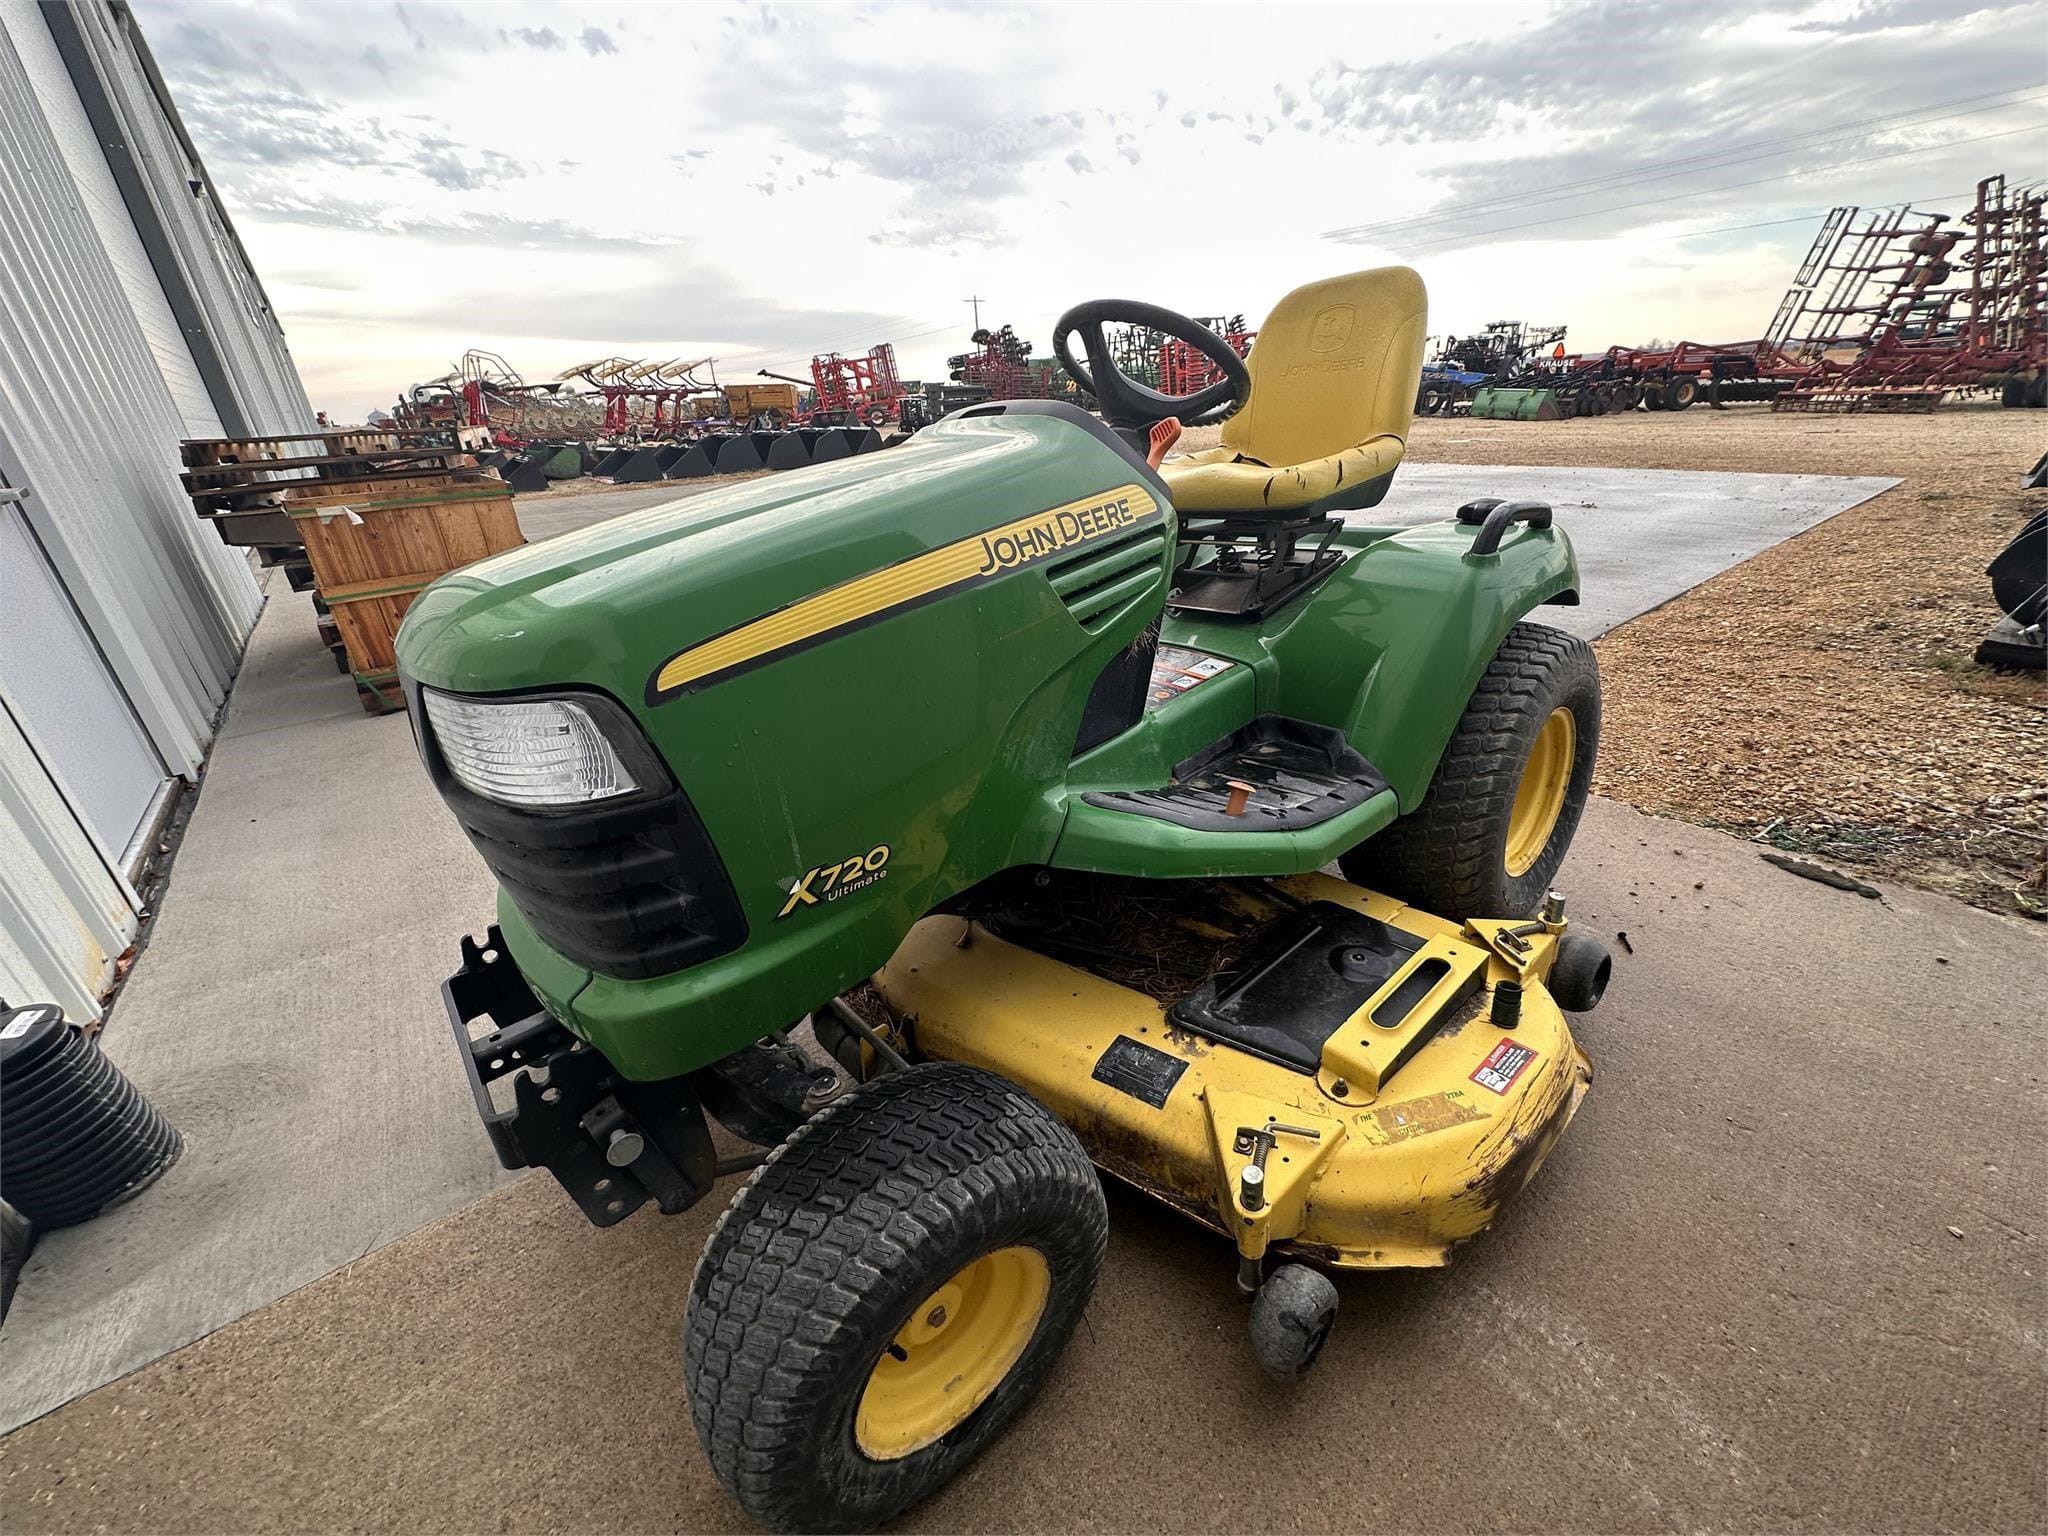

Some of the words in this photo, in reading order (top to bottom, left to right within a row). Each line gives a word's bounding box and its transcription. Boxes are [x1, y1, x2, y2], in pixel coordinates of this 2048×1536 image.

[1280, 364, 1319, 377] JOHN
[1321, 356, 1366, 374] DEERE
[1539, 359, 1575, 368] KRAUSE
[980, 523, 1058, 573] JOHN
[1055, 498, 1134, 543] DEERE
[778, 845, 890, 918] X720
[828, 870, 888, 902] Ultimate
[1446, 1090, 1465, 1100] XTRA
[1359, 1114, 1374, 1123] THE
